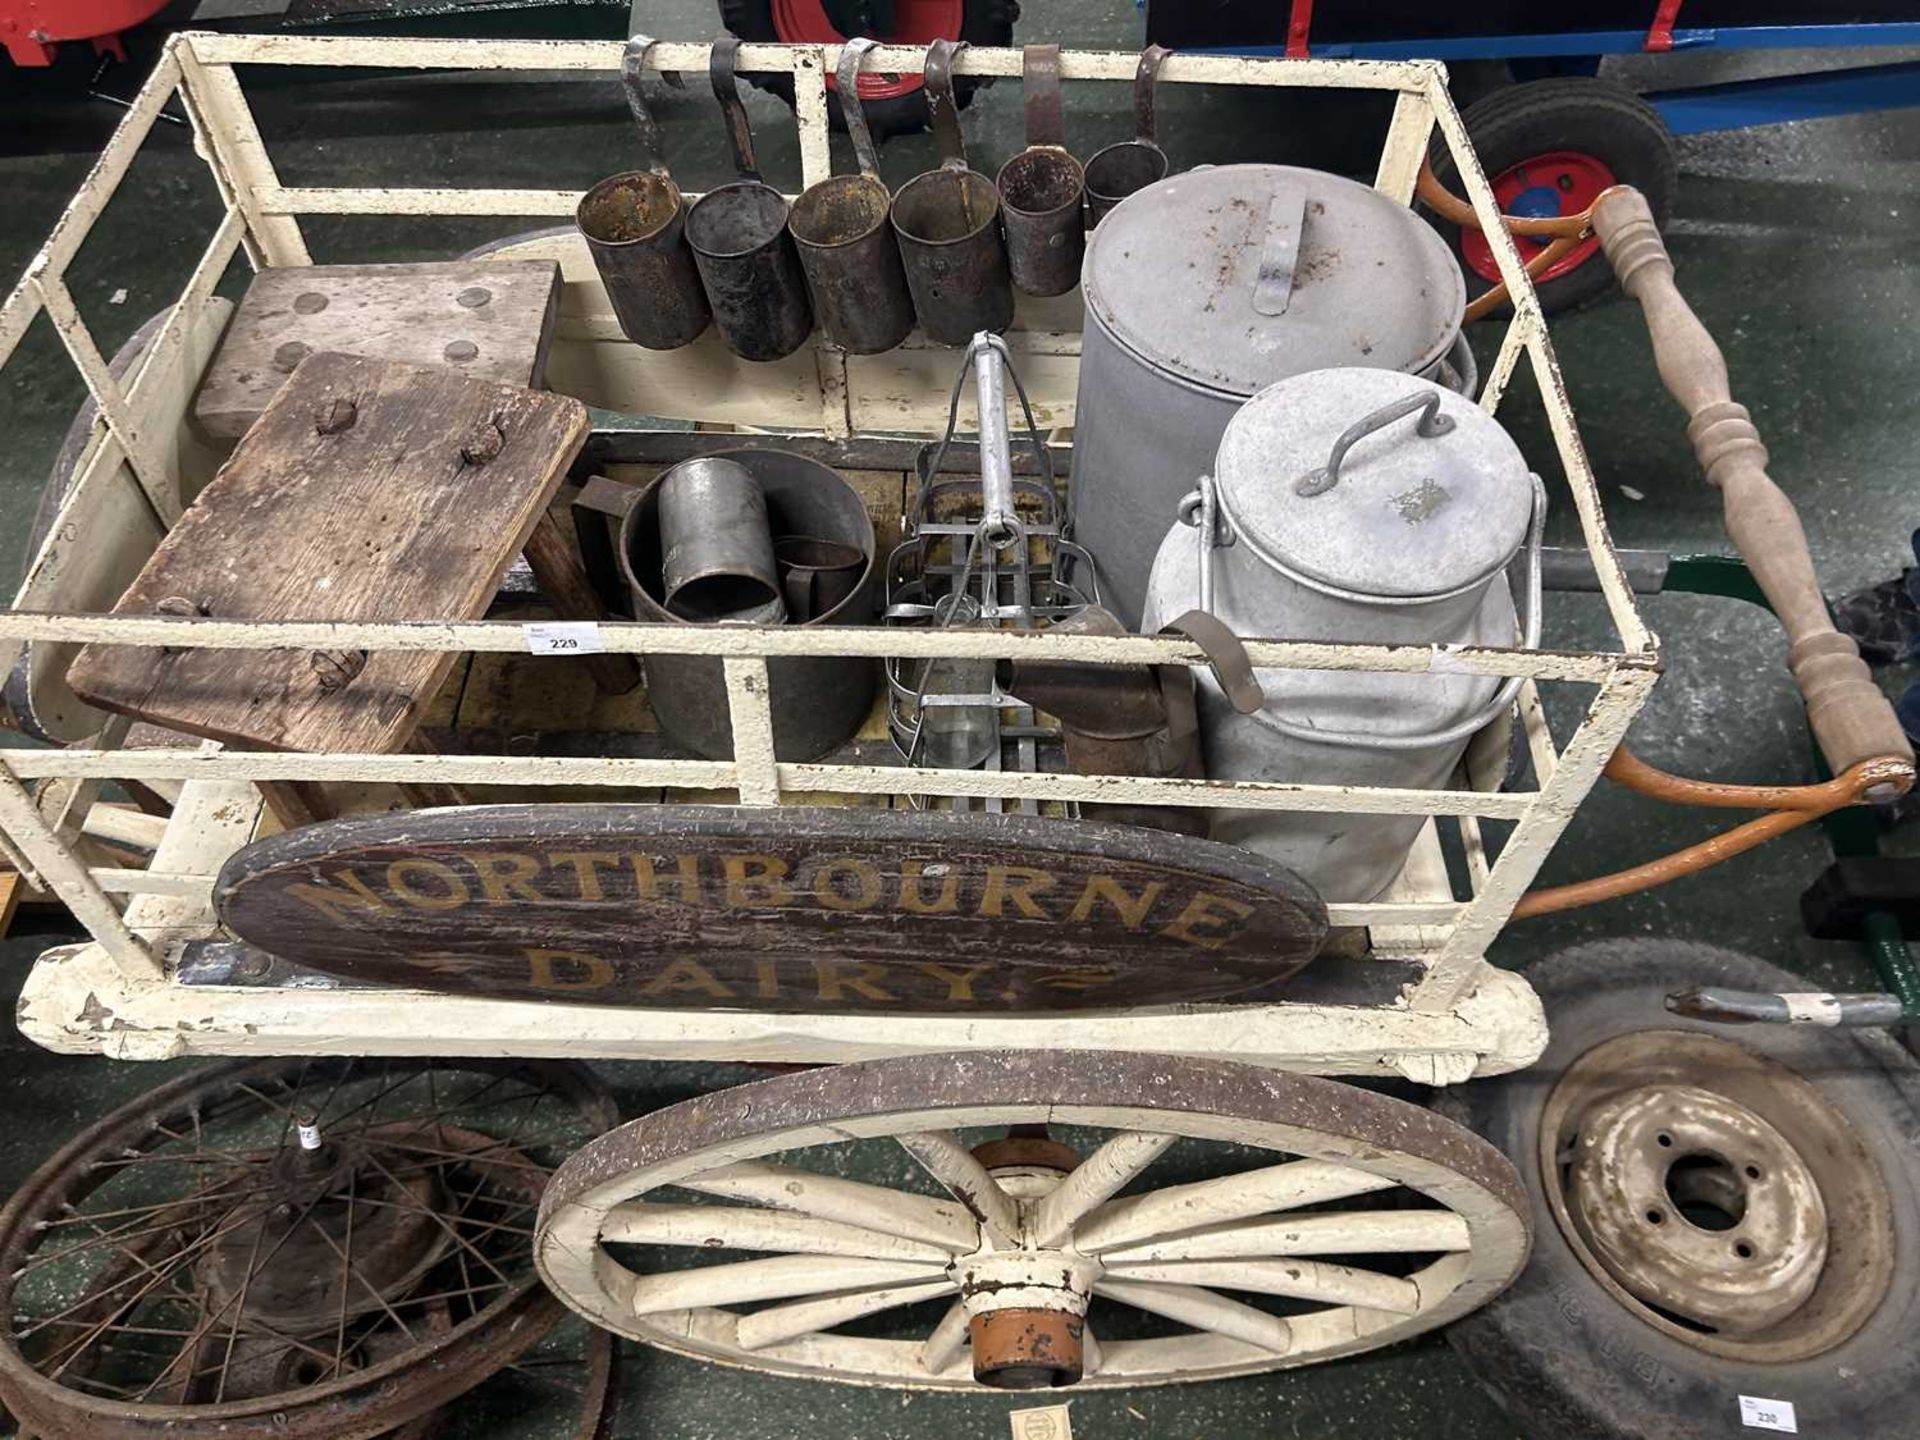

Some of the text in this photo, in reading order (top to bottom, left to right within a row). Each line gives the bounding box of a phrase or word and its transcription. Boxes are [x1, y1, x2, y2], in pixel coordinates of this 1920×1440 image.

[550, 638, 578, 649] 229
[284, 849, 1255, 950] NORTHBOURNE
[1757, 1411, 1778, 1425] 230
